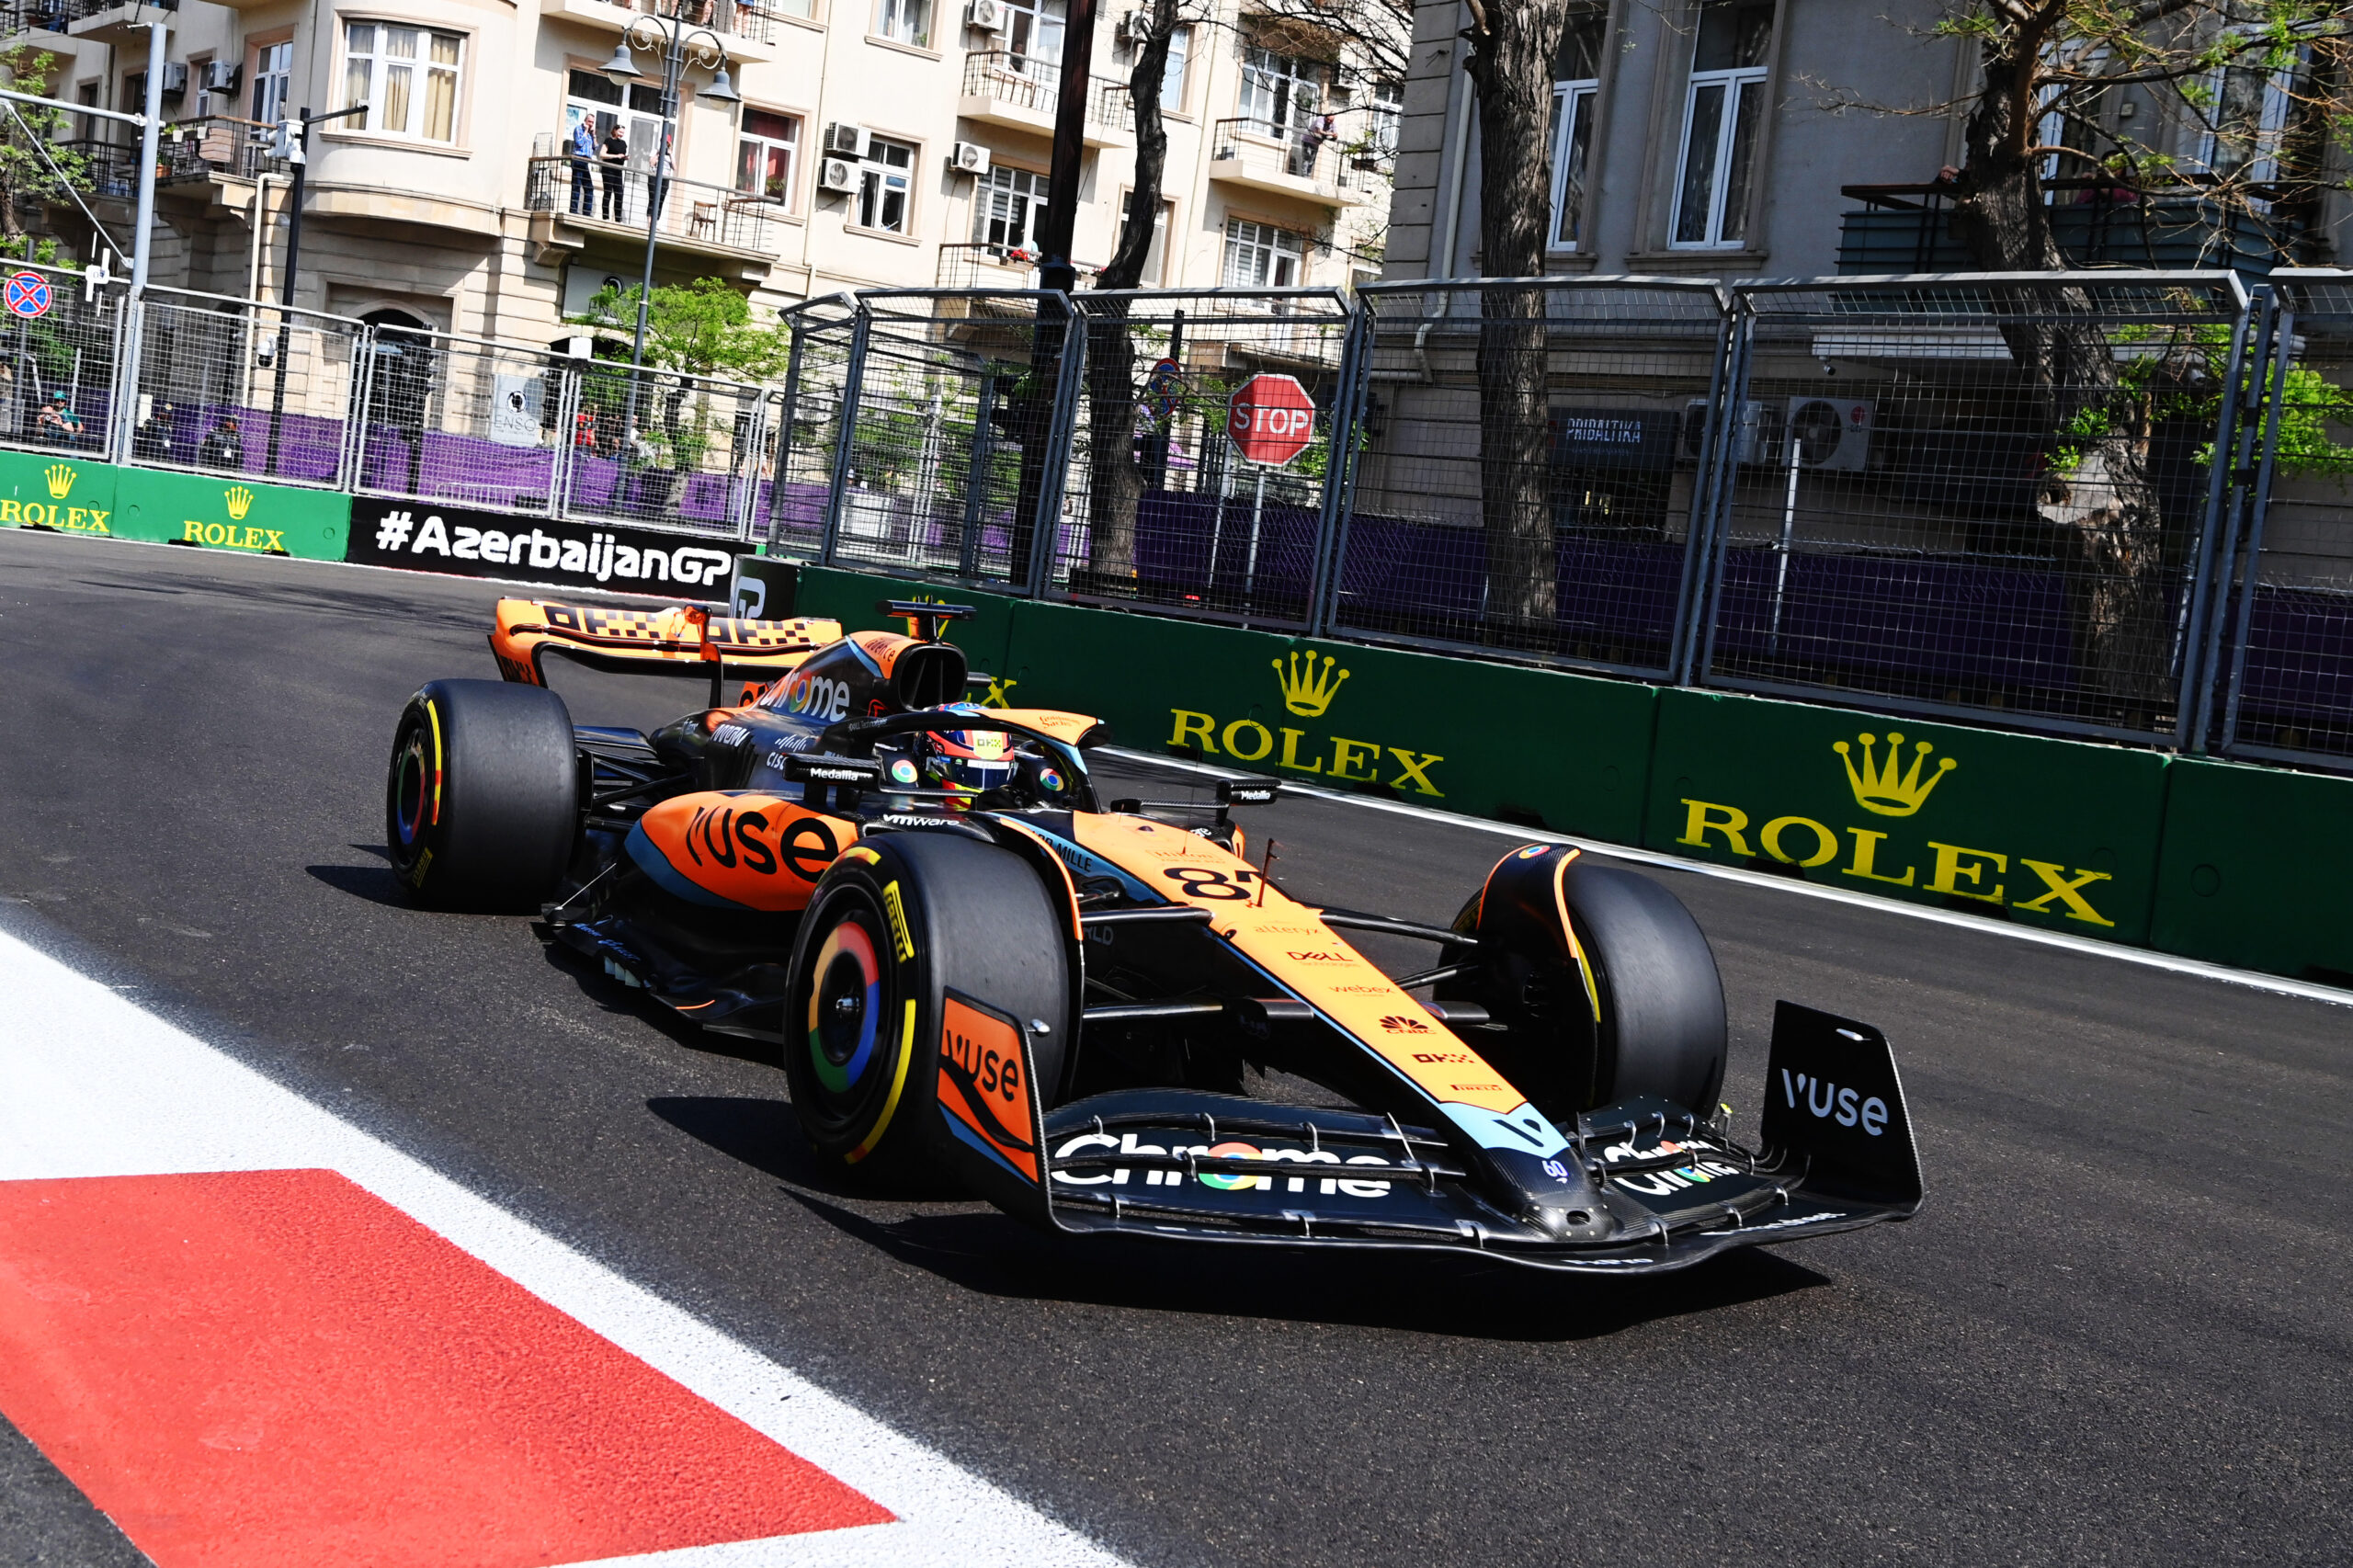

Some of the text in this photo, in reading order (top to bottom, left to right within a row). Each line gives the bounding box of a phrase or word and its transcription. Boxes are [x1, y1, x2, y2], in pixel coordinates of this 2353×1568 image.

[494, 415, 537, 432] ENSO
[1234, 402, 1309, 437] STOP
[0, 499, 110, 532] ROLEX
[184, 520, 285, 551] ROLEX
[375, 510, 732, 586] #AzerbaijanGP
[1165, 708, 1446, 798] ROLEX
[810, 767, 858, 781] Medallia
[883, 813, 960, 826] vmware
[1676, 798, 2115, 927] ROLEX
[1254, 926, 1323, 936] alteryx
[1327, 984, 1396, 994] webex
[1412, 1053, 1475, 1064] OKX
